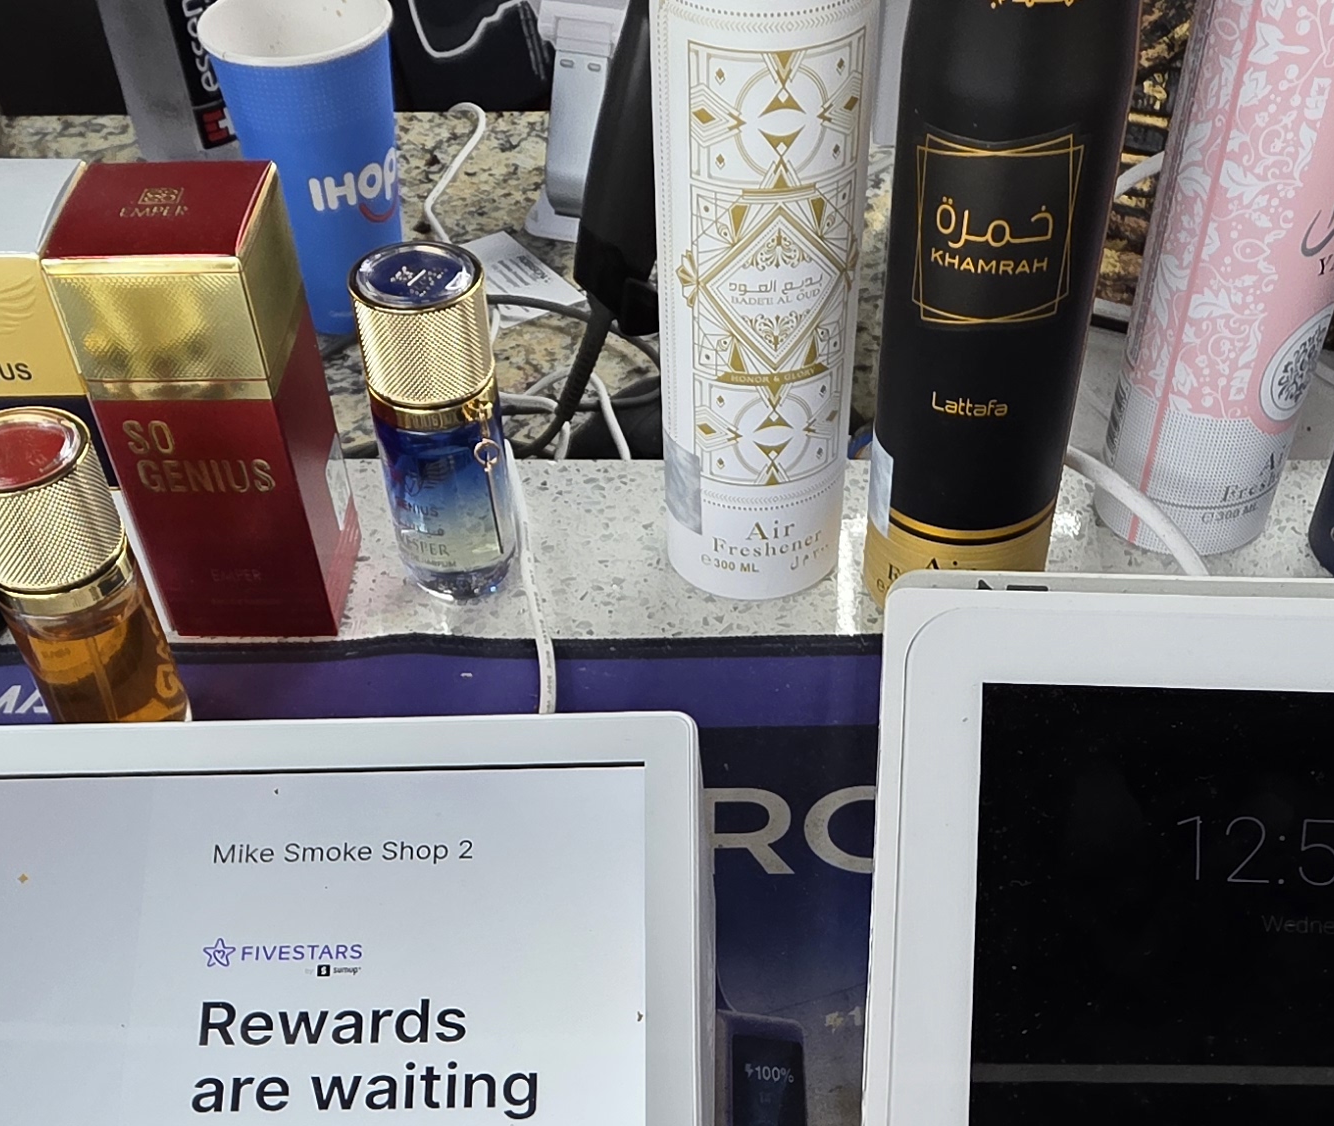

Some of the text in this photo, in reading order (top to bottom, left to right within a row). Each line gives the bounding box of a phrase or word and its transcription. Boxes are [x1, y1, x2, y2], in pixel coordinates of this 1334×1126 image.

[308, 146, 398, 213] IHOP
[119, 203, 190, 219] EMPER
[934, 195, 1055, 246] خمرة
[929, 249, 1049, 276] KHAMRAH
[930, 391, 1009, 418] Lattafa
[123, 420, 176, 456] SO
[137, 458, 276, 495] GENIUS
[712, 530, 822, 558] Freshener
[746, 520, 795, 541] Air
[714, 558, 760, 573] 300 ML
[213, 839, 474, 866] Mike Smoke Shop 2
[241, 943, 363, 963] FIVESTARS
[198, 998, 468, 1048] Rewards
[754, 1064, 795, 1084] 100%
[192, 1061, 539, 1120] are waiting
